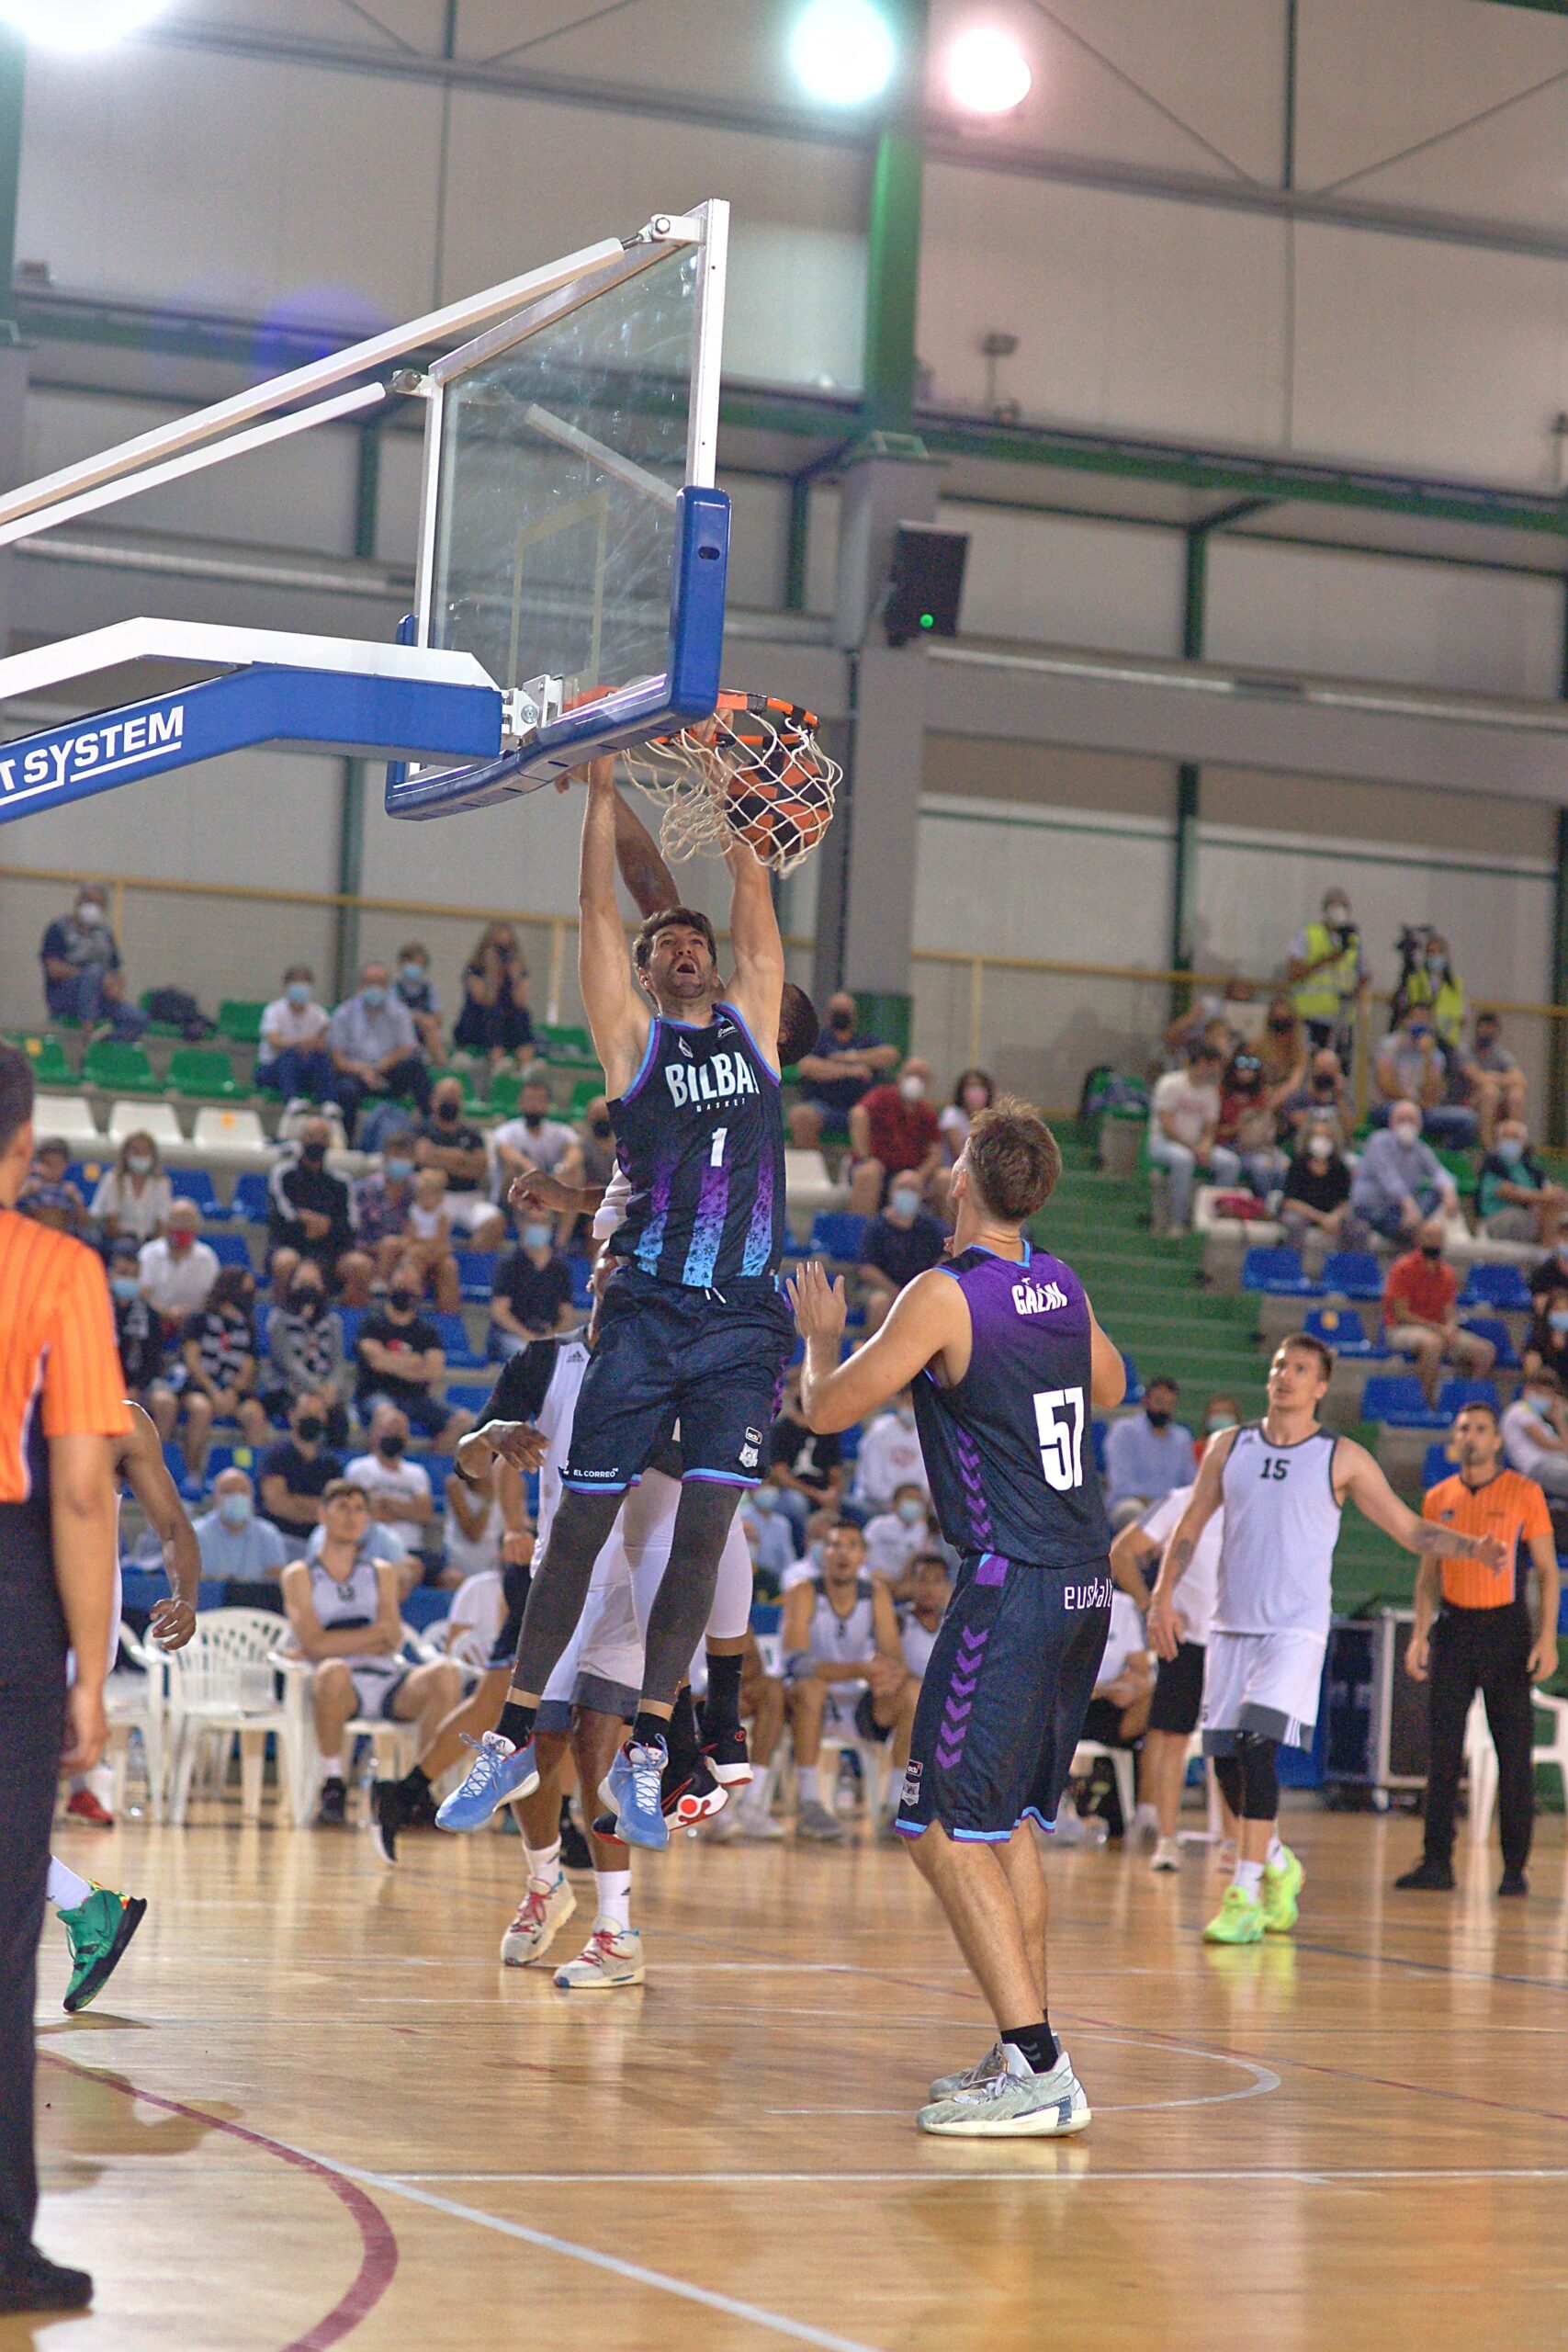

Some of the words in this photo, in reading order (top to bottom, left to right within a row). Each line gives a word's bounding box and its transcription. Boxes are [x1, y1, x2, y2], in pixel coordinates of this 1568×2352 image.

[24, 706, 184, 786] SYSTEM
[696, 1097, 746, 1113] BASKET
[710, 1127, 728, 1167] 1
[1032, 1386, 1084, 1491] 57
[583, 1470, 616, 1478] CORREO
[1260, 1457, 1291, 1480] 15
